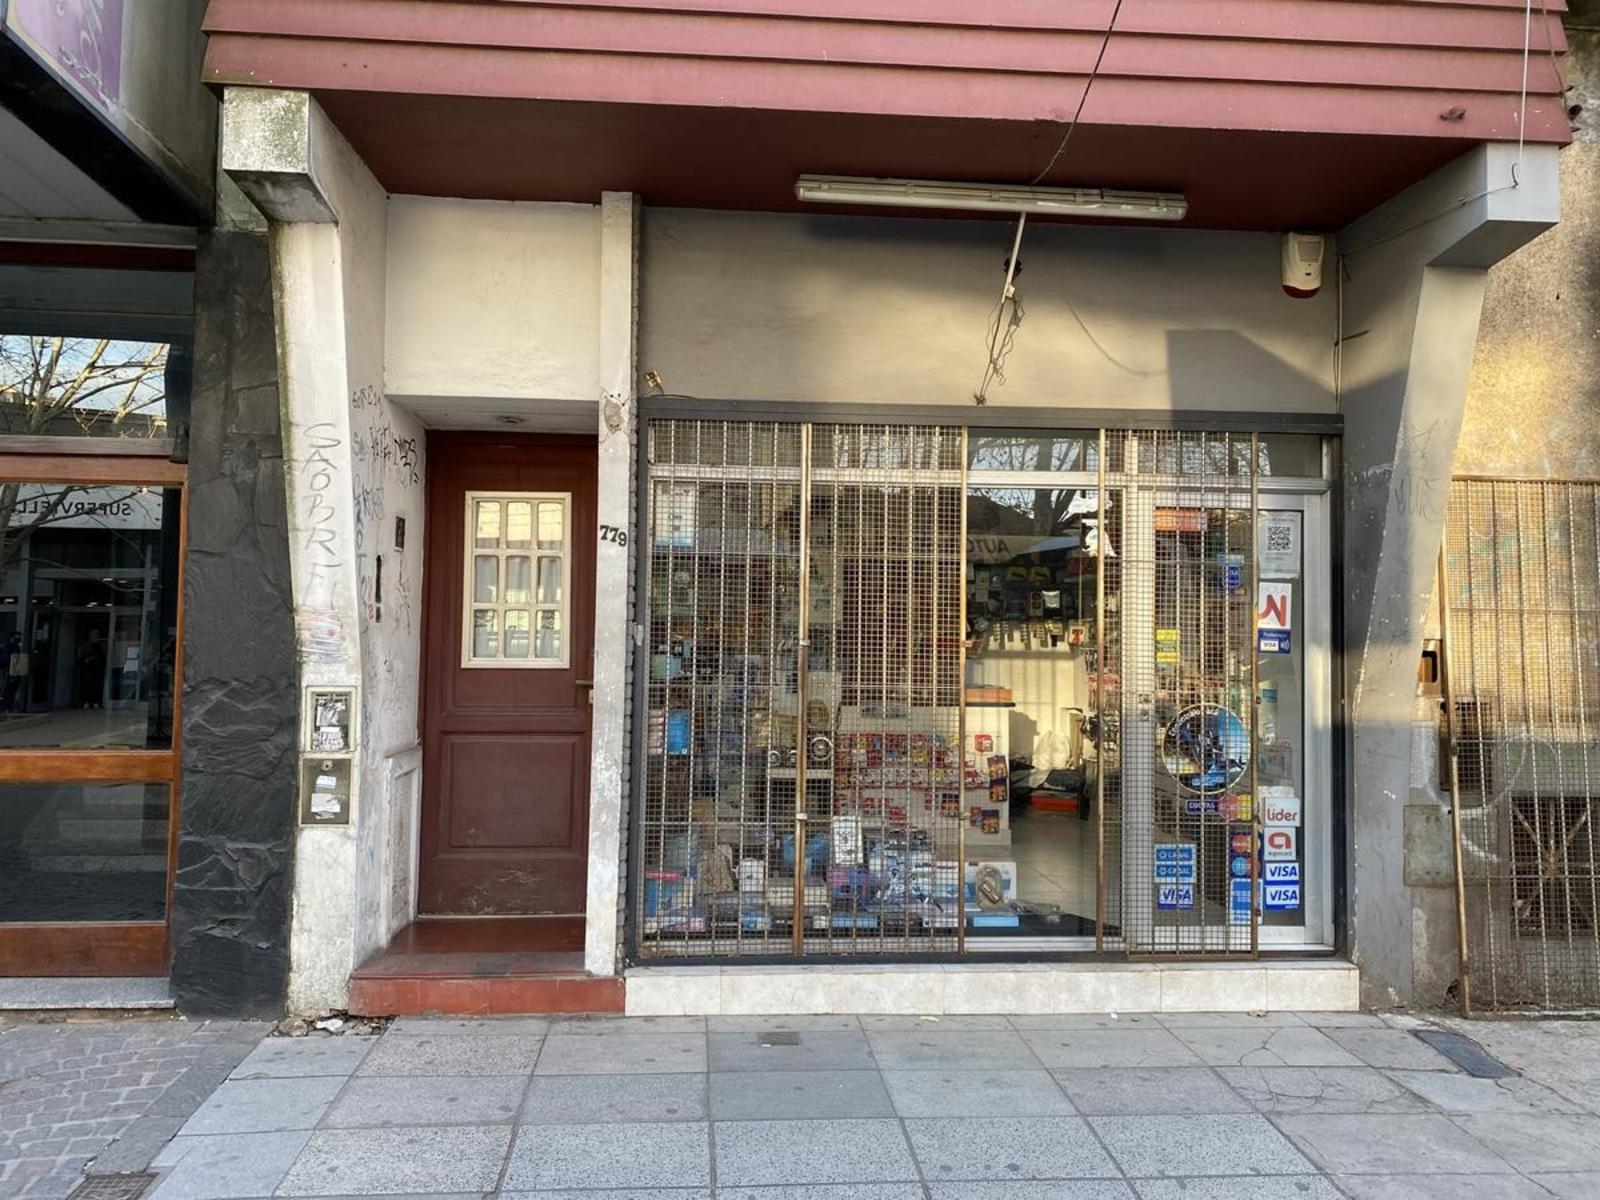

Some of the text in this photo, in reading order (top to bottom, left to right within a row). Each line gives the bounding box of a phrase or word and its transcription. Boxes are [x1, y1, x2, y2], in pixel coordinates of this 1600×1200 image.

[599, 525, 628, 547] 779
[1268, 866, 1298, 877] VISA
[1269, 889, 1299, 901] VISA
